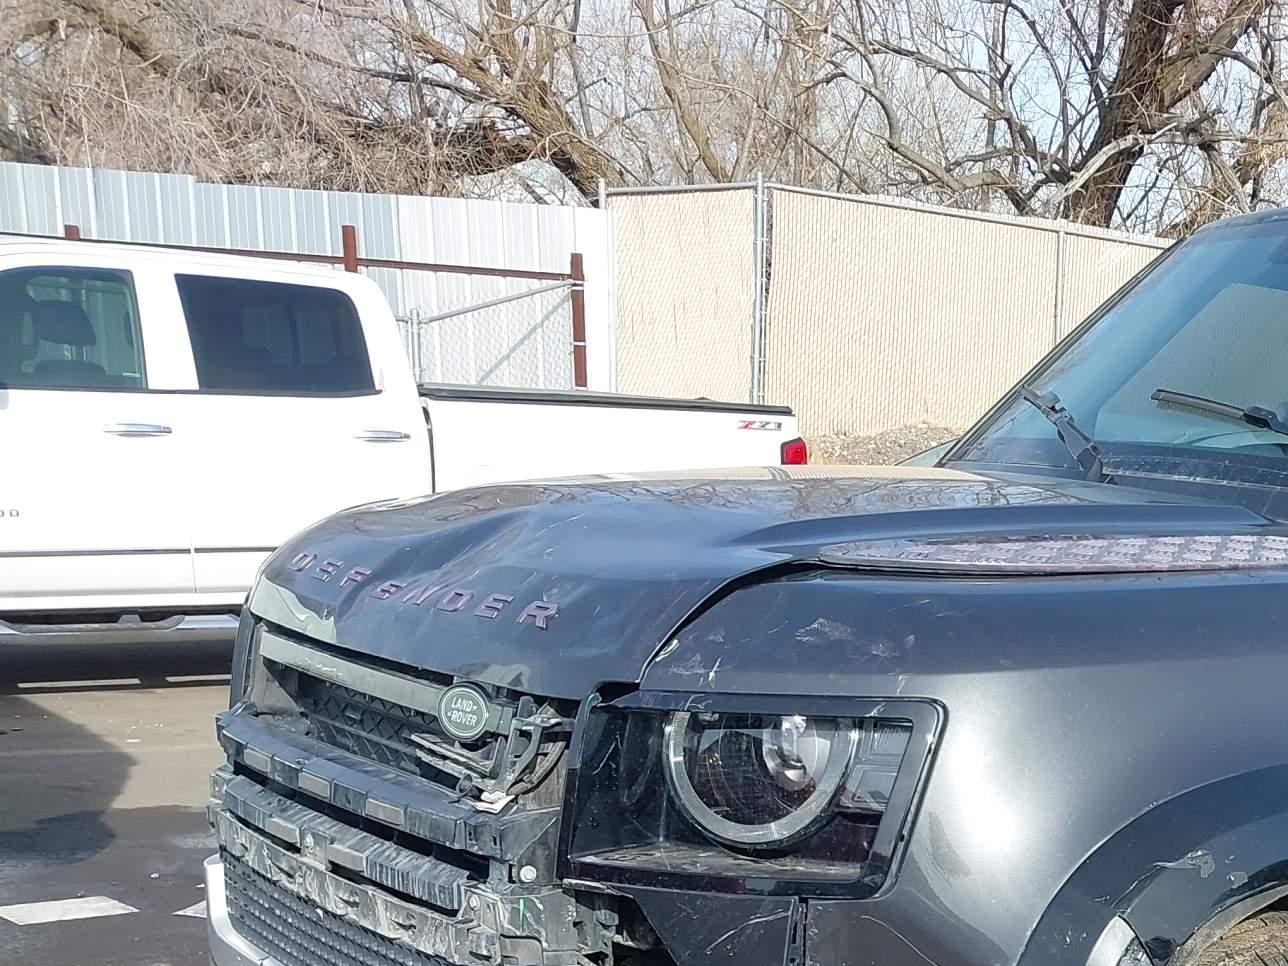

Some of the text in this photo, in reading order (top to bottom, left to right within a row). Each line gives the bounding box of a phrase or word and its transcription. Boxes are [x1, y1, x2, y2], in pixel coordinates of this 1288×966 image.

[286, 552, 561, 630] DEFENDER
[451, 696, 474, 712] LAND
[450, 709, 478, 727] ROVER
